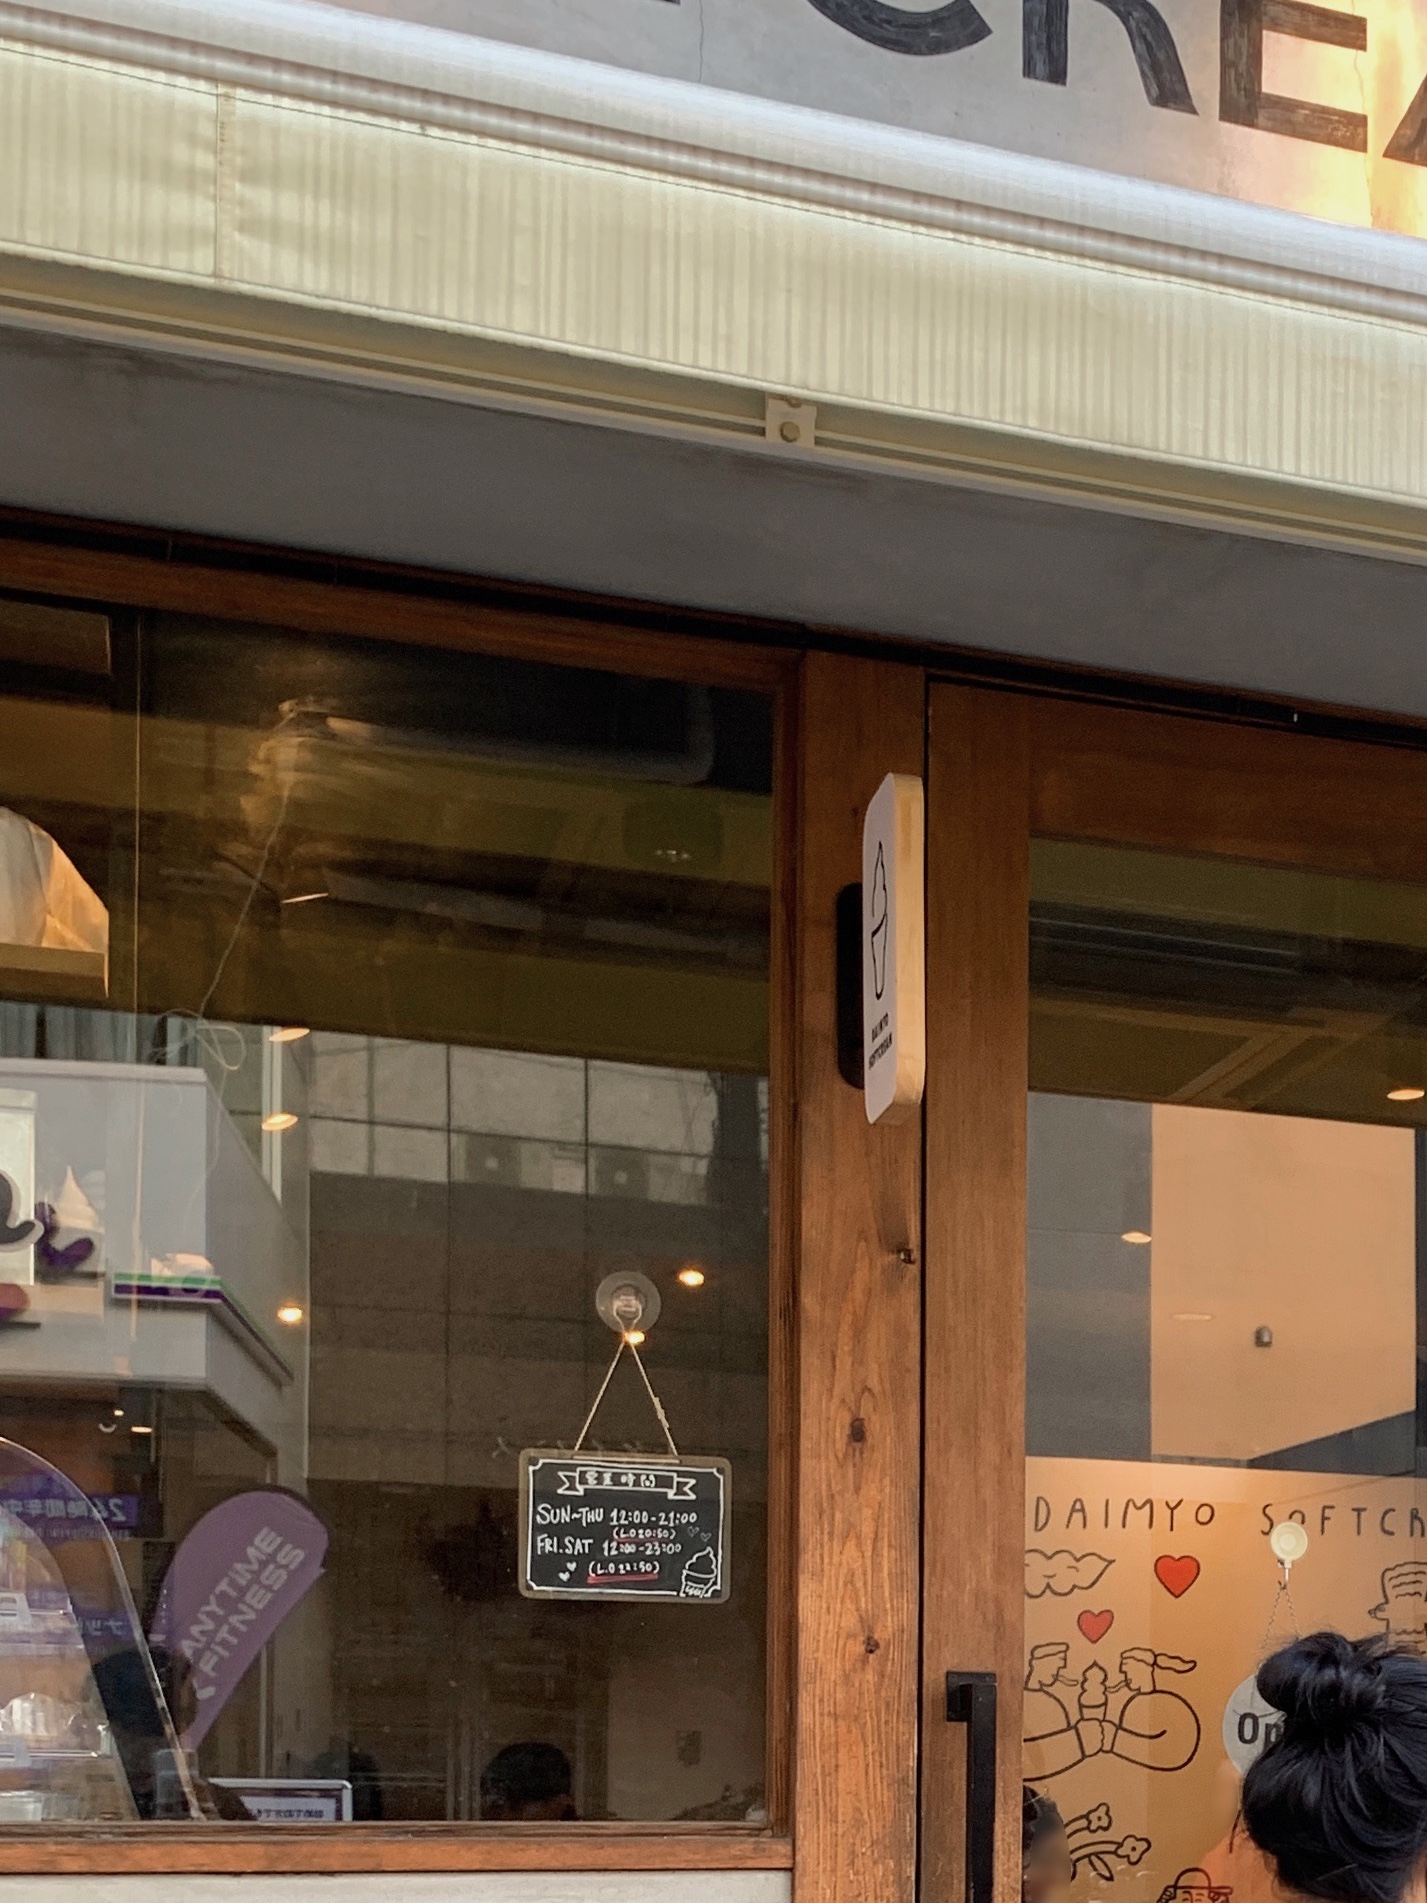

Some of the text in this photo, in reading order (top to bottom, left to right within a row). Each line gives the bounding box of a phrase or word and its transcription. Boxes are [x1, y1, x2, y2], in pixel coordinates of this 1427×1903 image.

[1033, 1496, 1217, 1534] DAIMYO
[183, 1526, 283, 1659] ANYTIME
[200, 1542, 306, 1678] FITNESS
